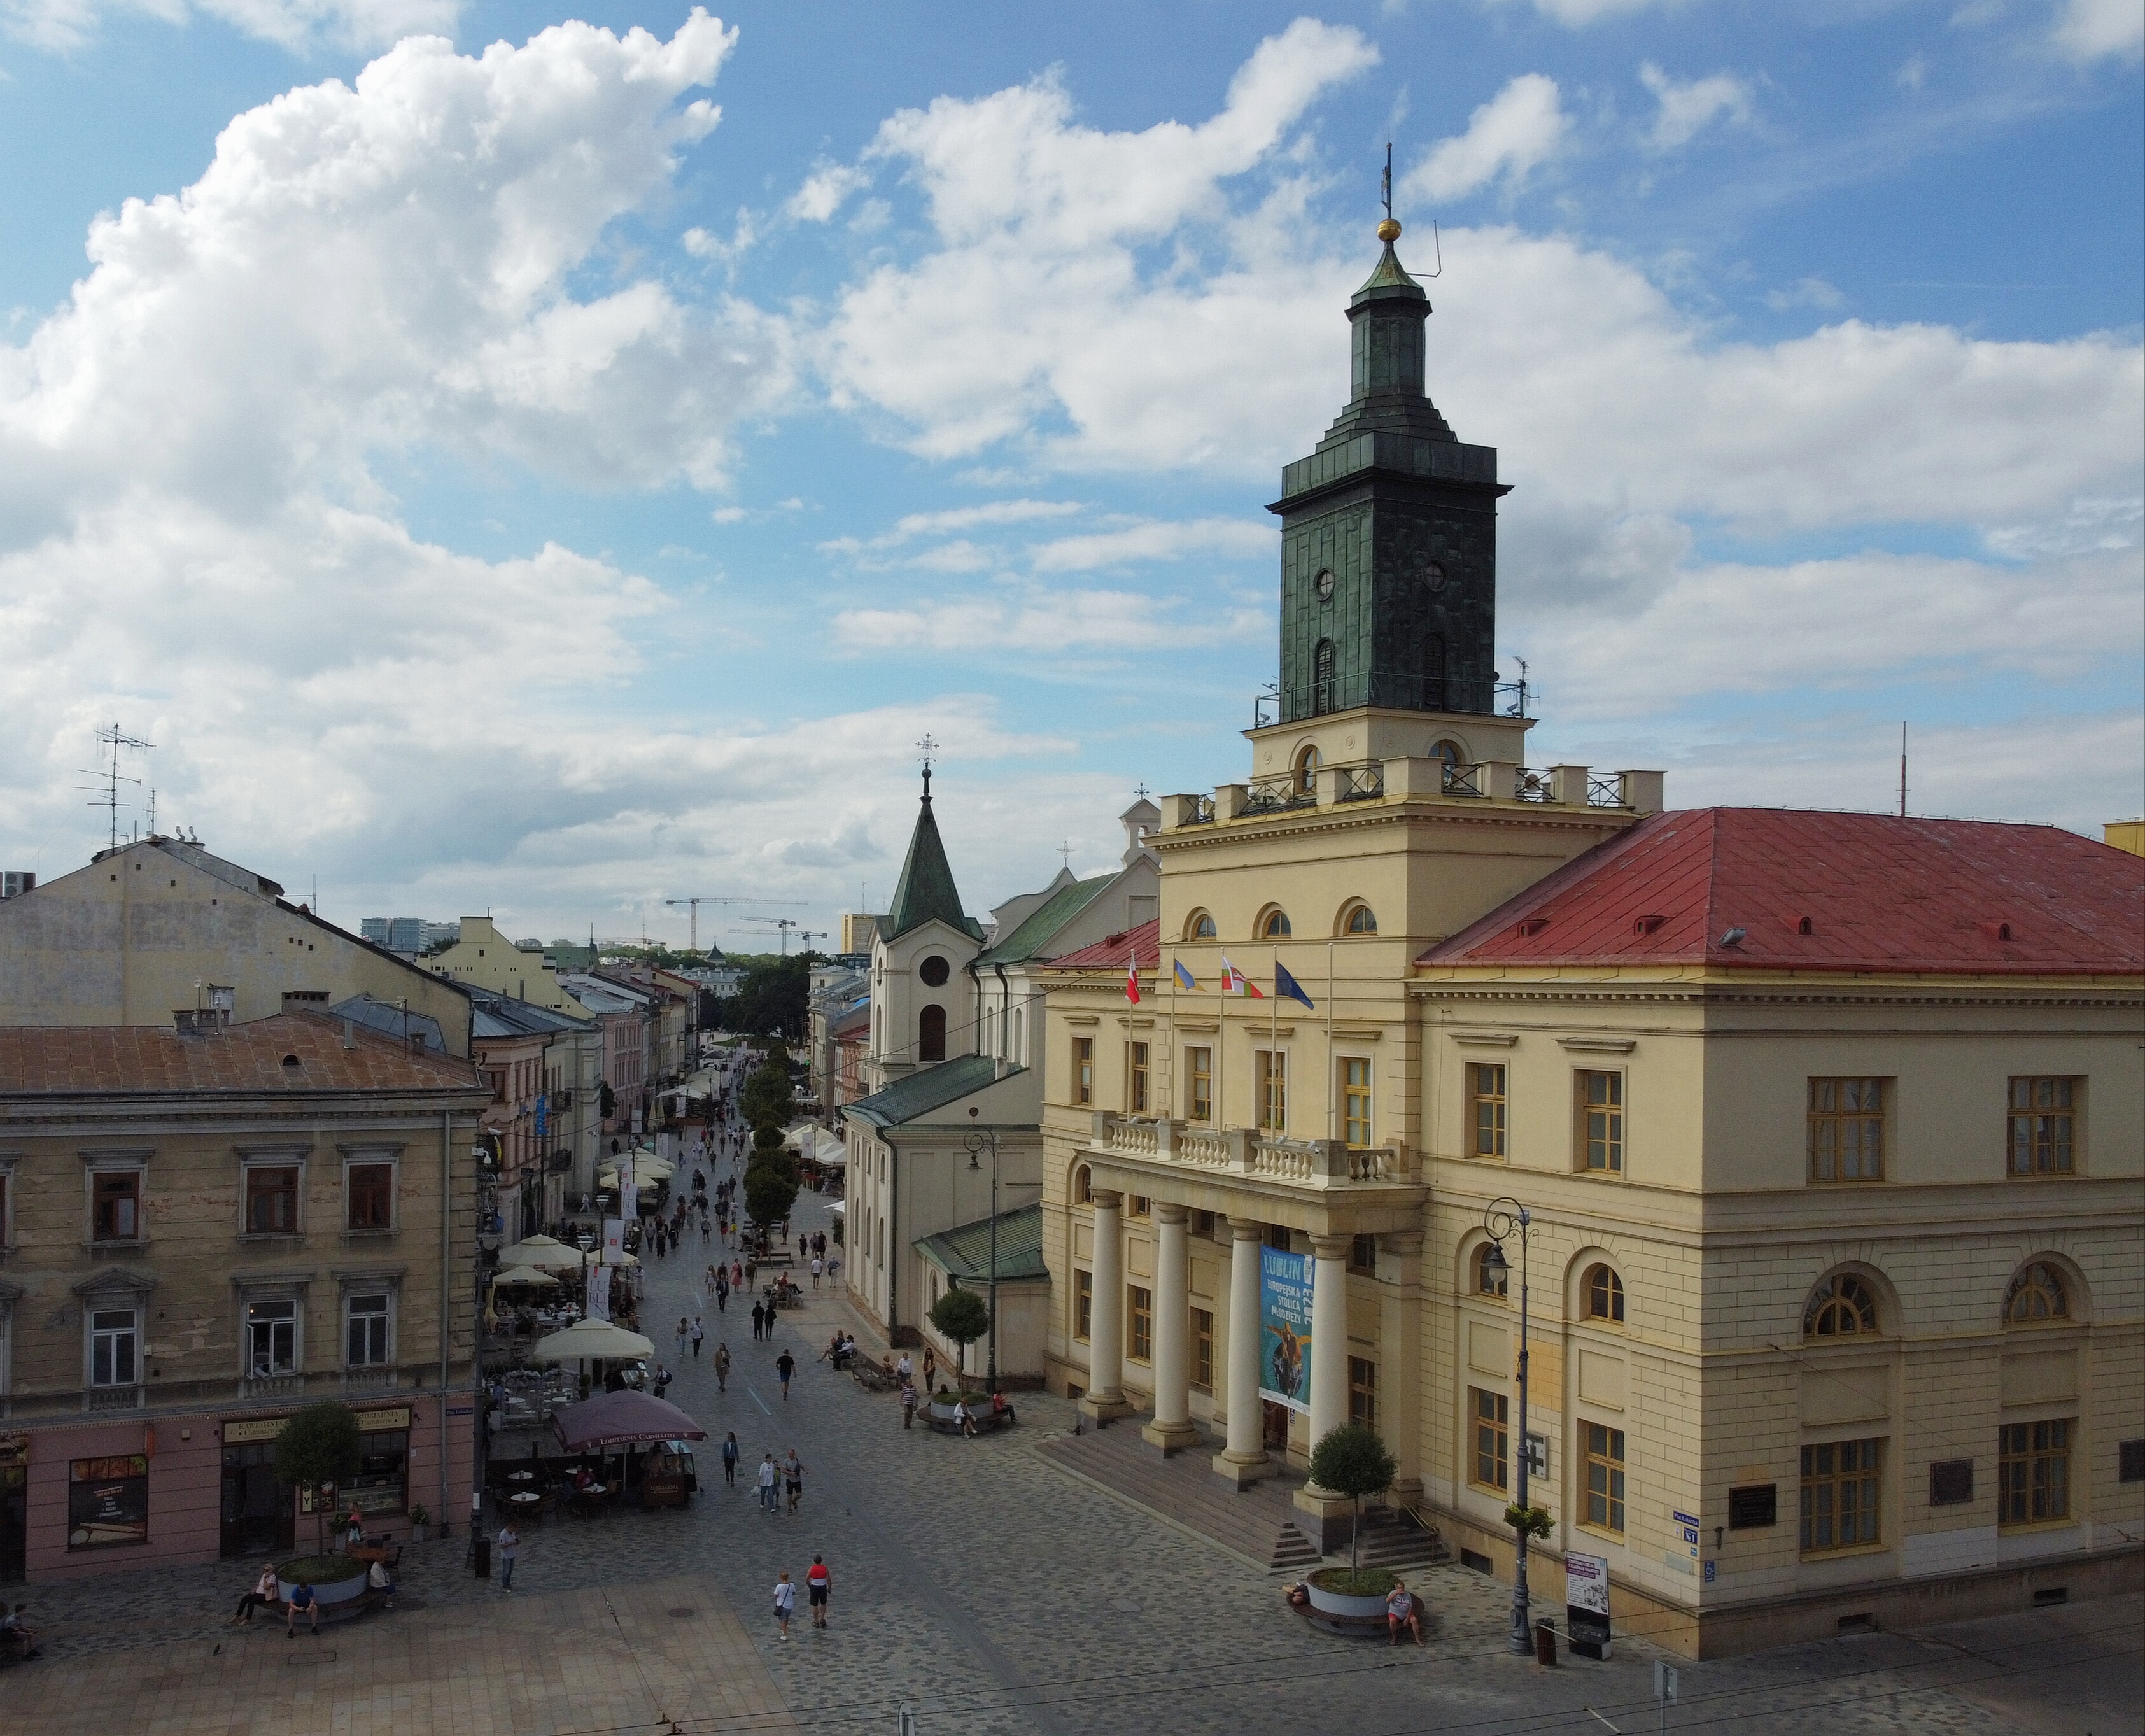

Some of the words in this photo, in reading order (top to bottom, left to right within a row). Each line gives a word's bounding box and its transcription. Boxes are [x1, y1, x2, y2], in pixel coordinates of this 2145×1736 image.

[1264, 1255, 1301, 1280] LUBLIN
[589, 1280, 606, 1292] LU
[1267, 1279, 1300, 1298] EUROPEJSKA
[589, 1292, 607, 1304] BLI
[1278, 1295, 1301, 1311] STOLICA
[595, 1304, 605, 1315] N
[1271, 1305, 1301, 1324] MŁODZIEŻY
